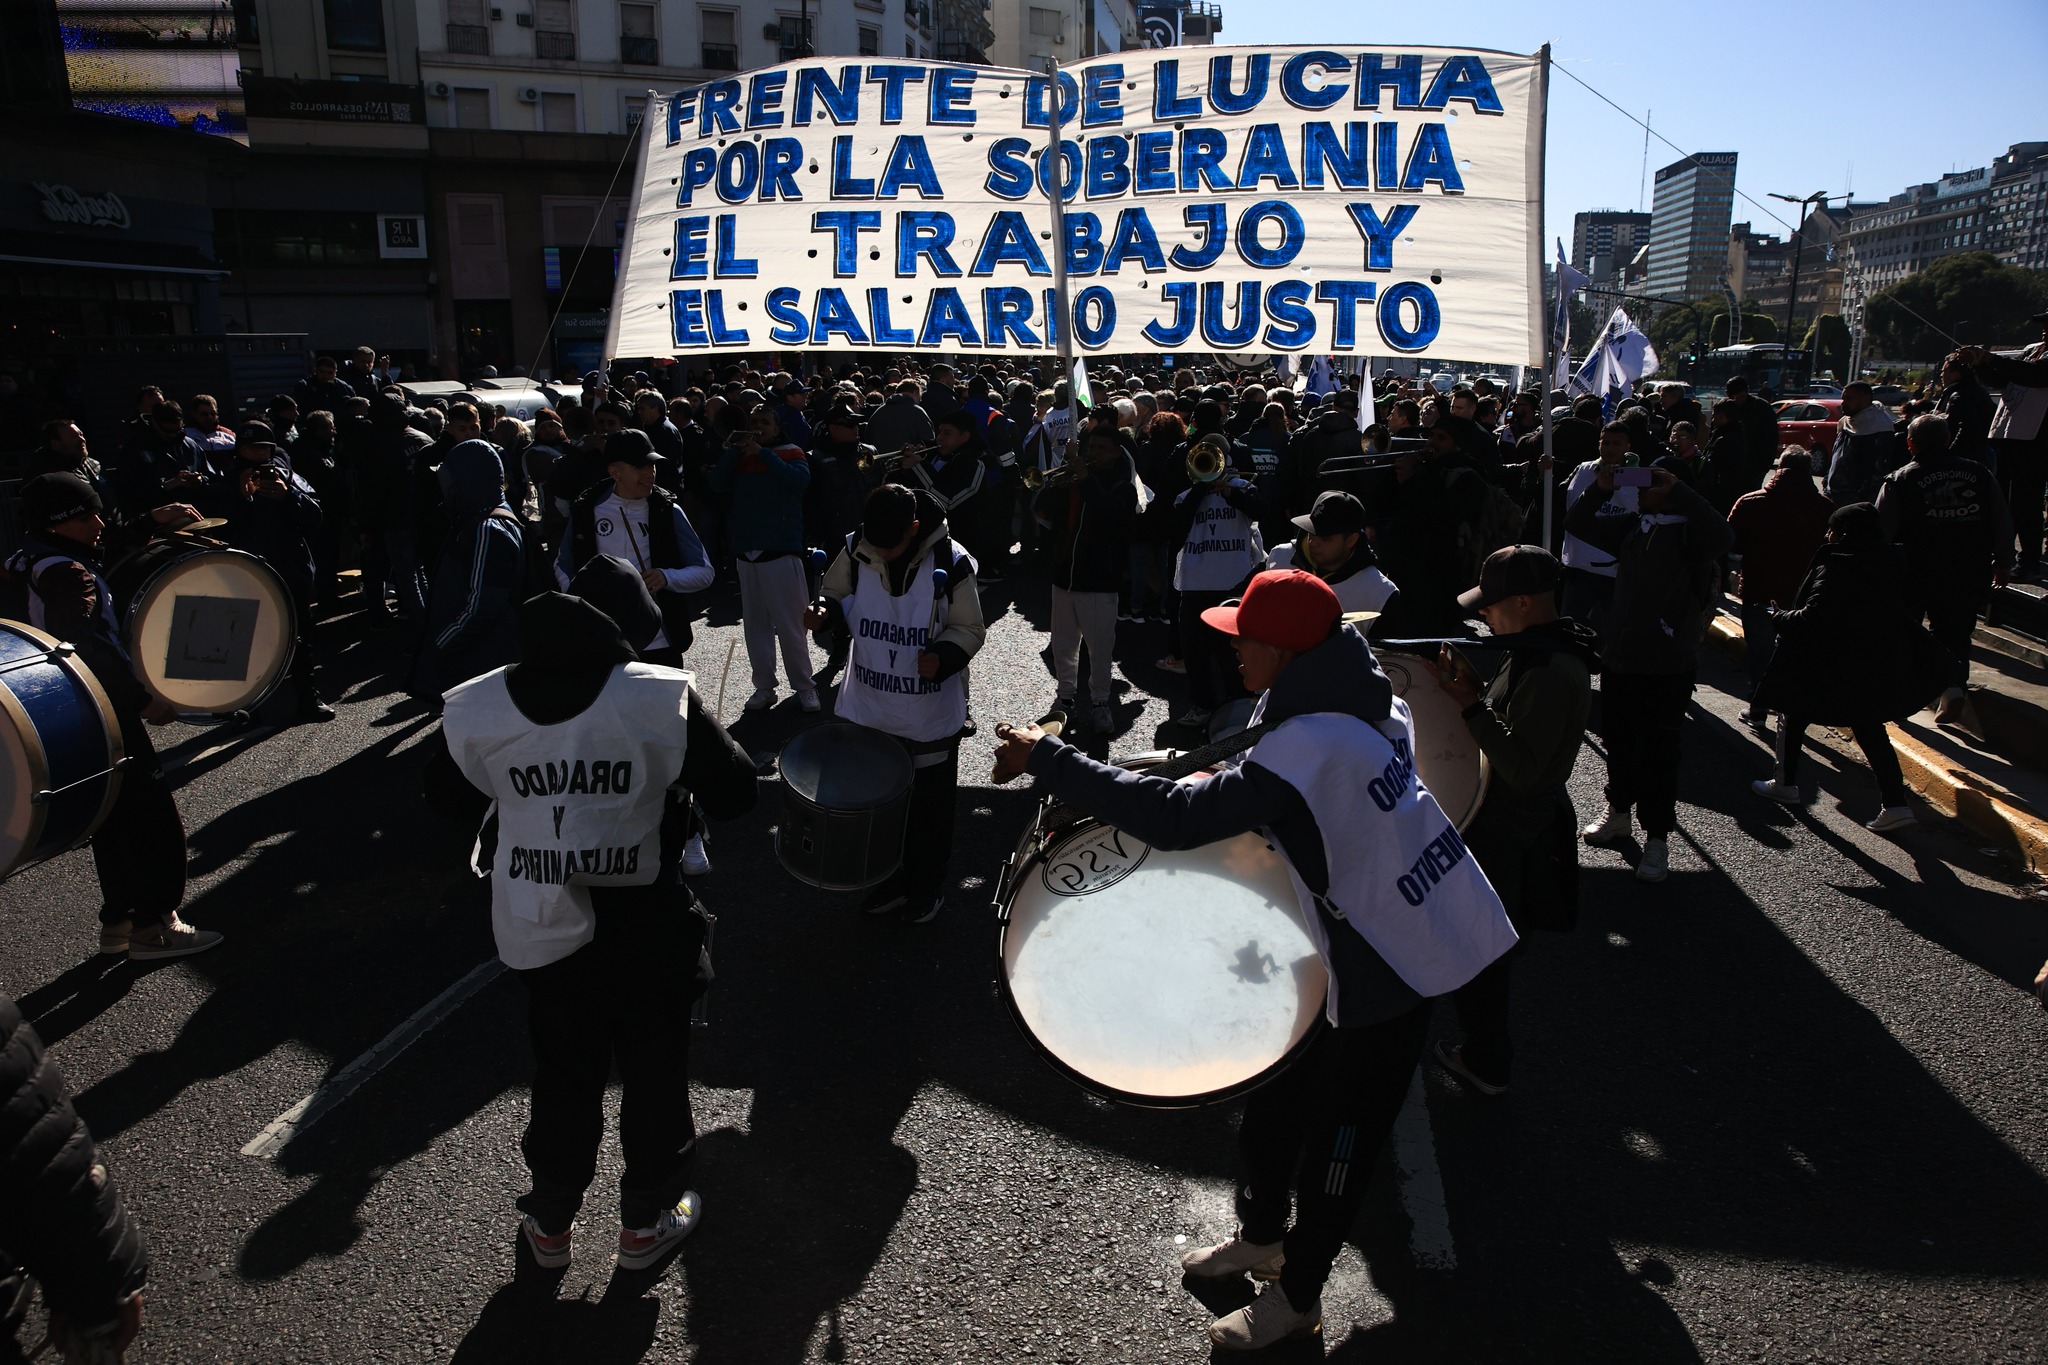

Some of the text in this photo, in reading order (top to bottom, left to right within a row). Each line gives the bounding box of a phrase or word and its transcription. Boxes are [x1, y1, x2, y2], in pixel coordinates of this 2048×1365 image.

[666, 51, 1505, 147] FRENTE DE LUCHA
[676, 121, 1465, 208] POR LA SOBERANIA
[669, 200, 1421, 281] EL TRABAJO Y
[669, 280, 1442, 353] EL SALARIO JUSTO
